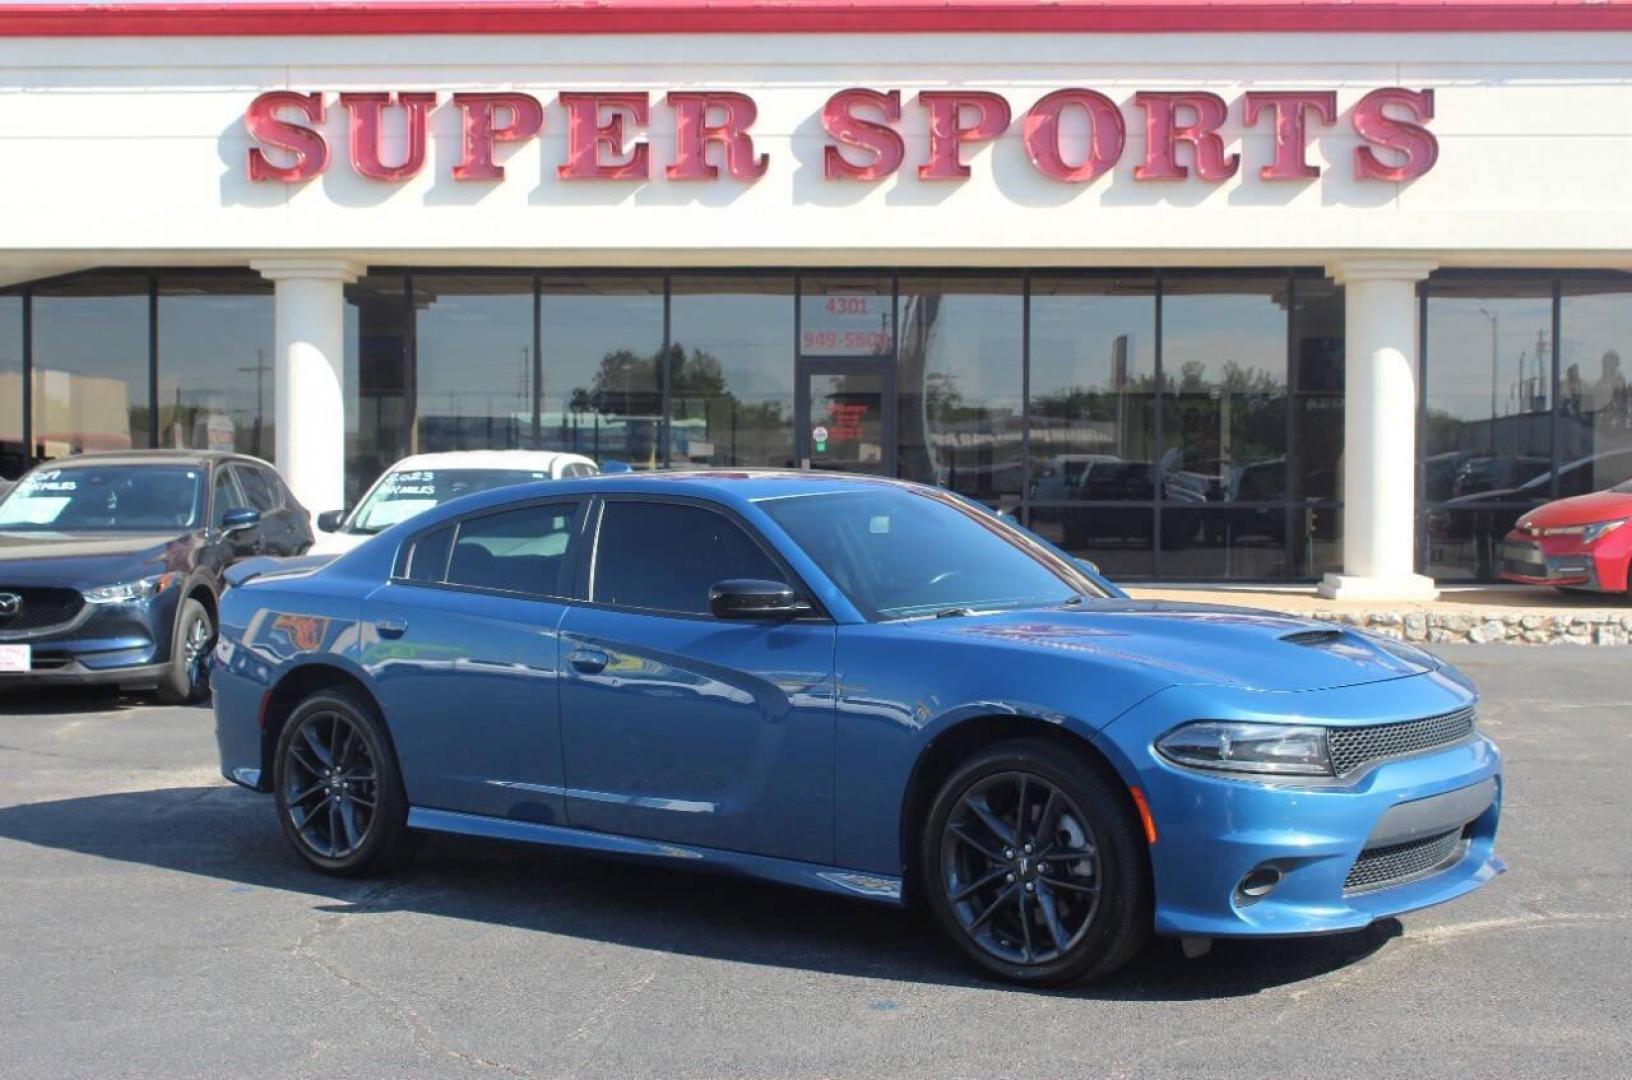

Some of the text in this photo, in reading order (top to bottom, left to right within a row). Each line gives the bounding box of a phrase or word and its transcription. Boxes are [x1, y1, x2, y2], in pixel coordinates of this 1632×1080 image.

[245, 87, 1439, 182] SUPER SPORTS
[825, 297, 867, 314] 4301
